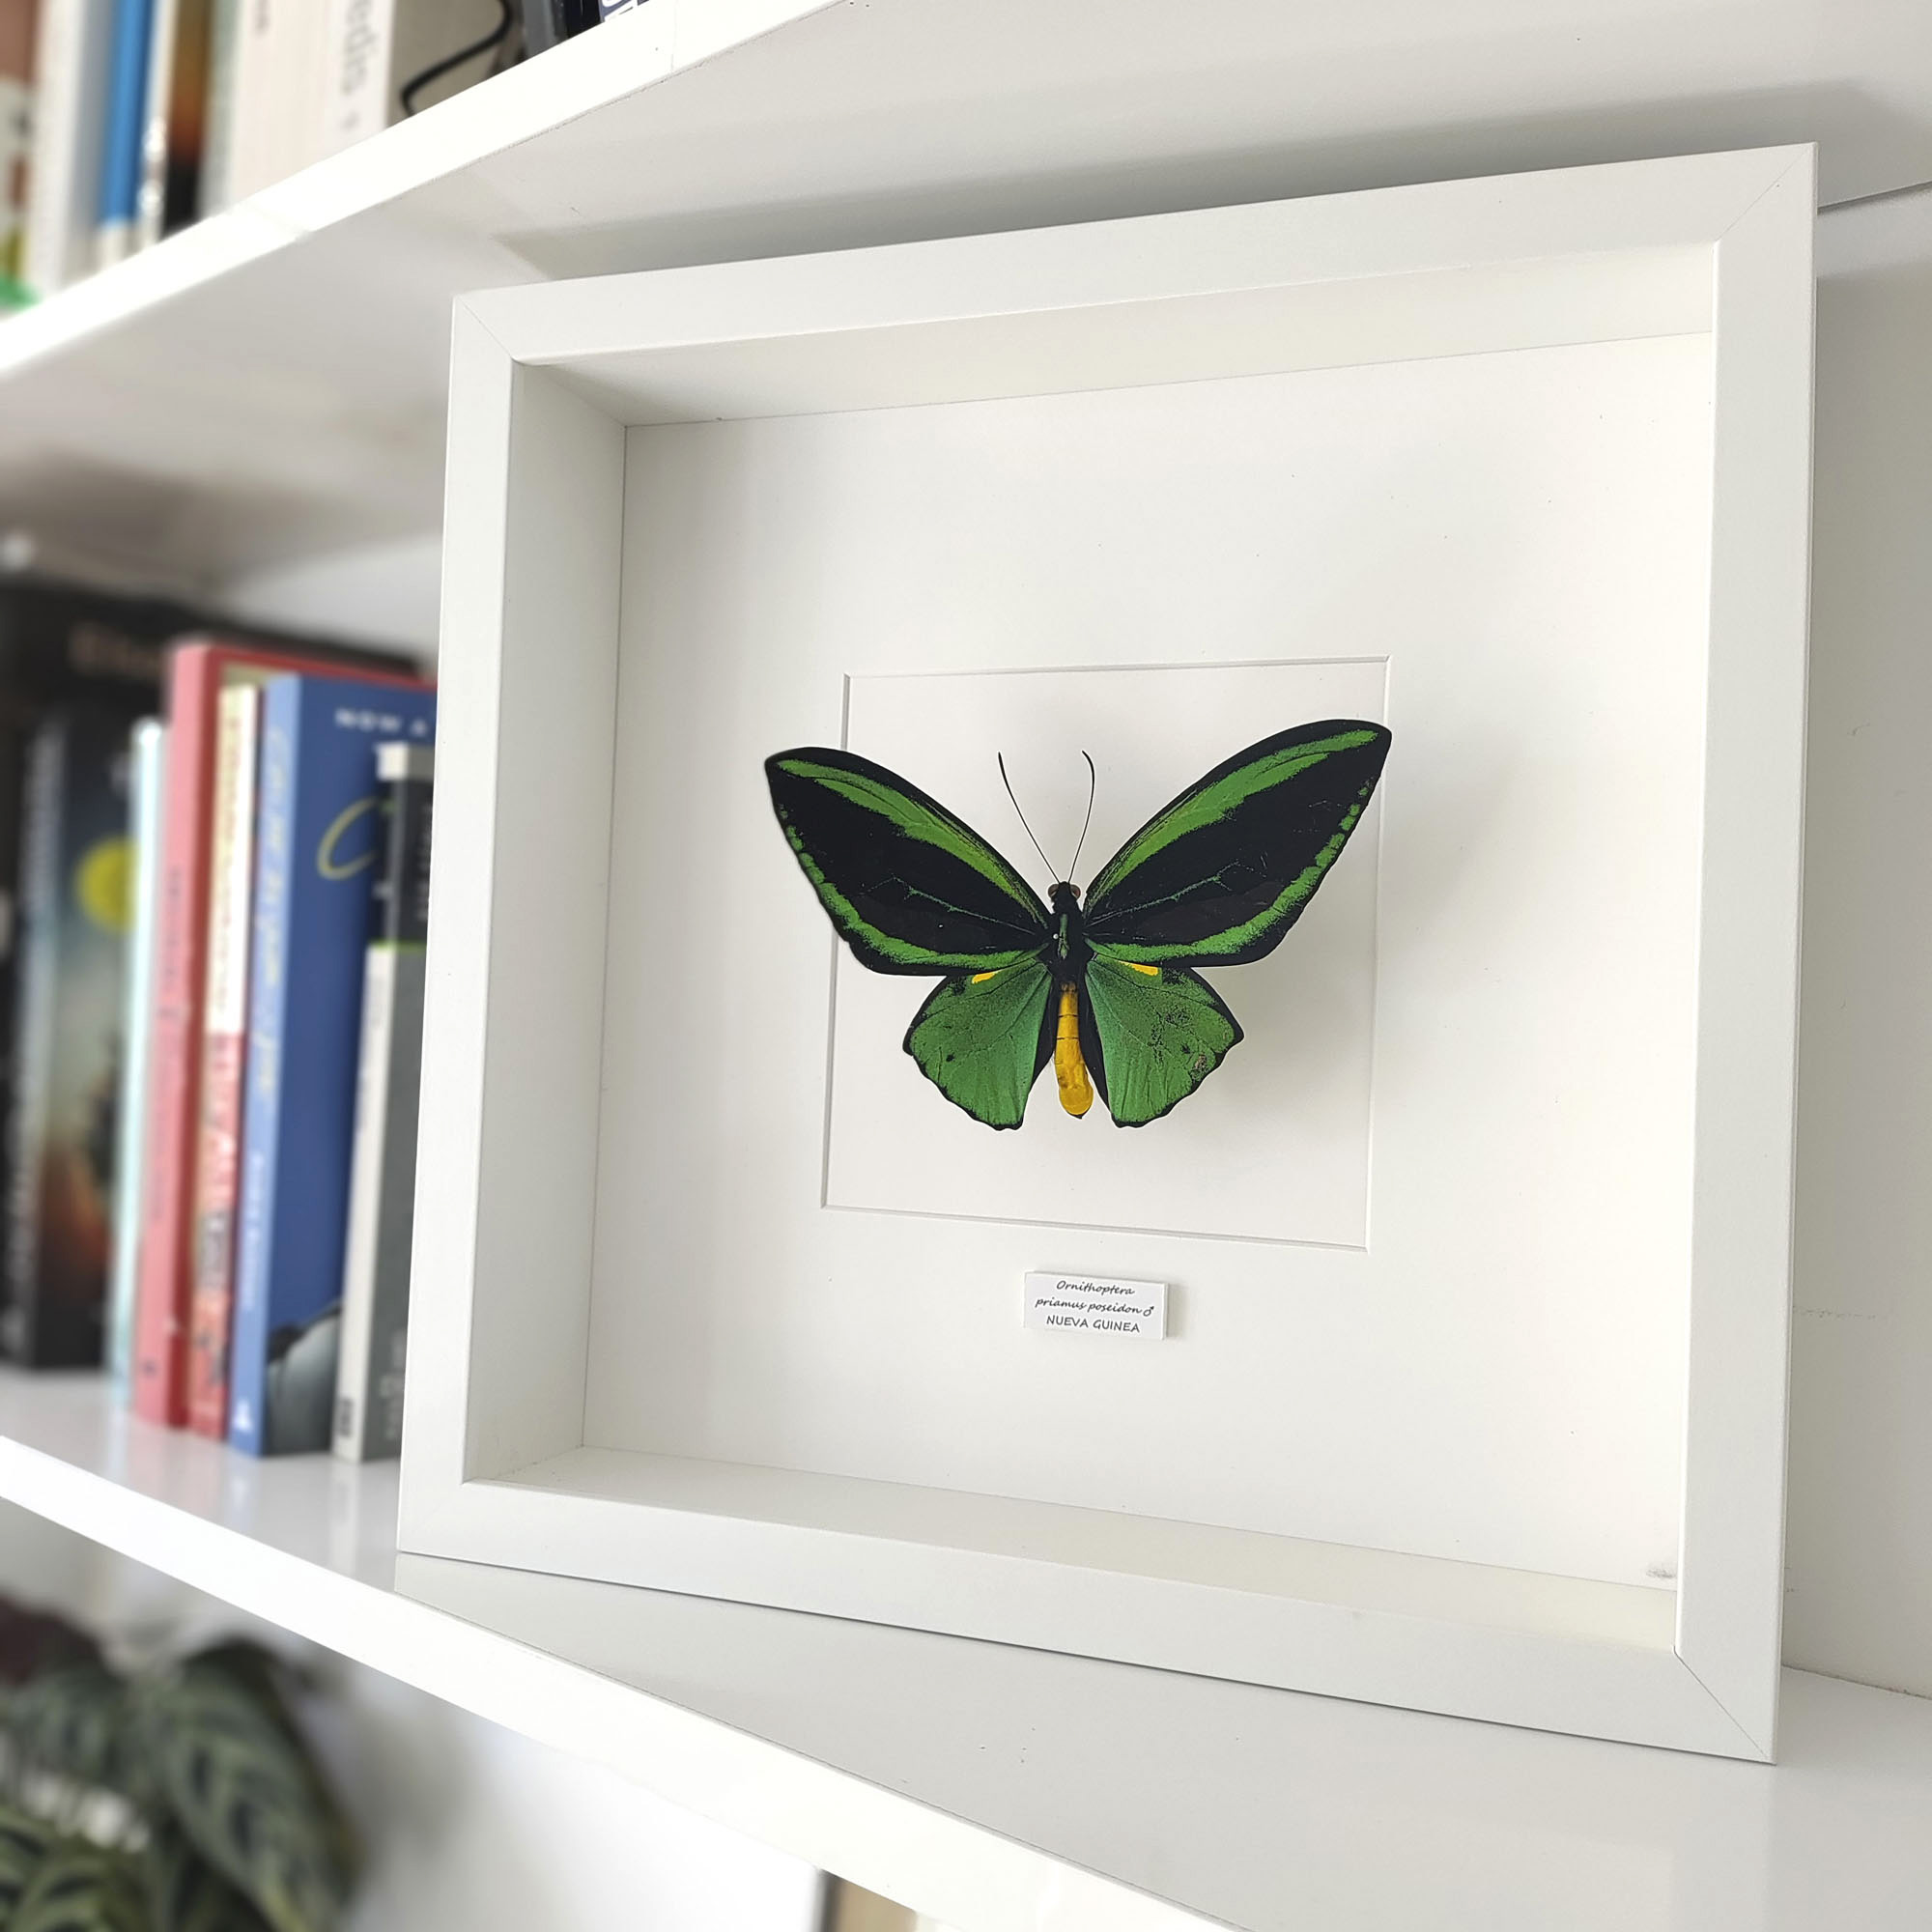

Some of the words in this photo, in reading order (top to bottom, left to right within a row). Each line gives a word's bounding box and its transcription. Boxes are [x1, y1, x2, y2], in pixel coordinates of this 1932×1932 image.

[1056, 1280, 1135, 1295] Ornithoptera
[1035, 1296, 1087, 1310] priamus
[1087, 1302, 1143, 1315] poseidon
[1046, 1315, 1089, 1328] NUEVA
[1093, 1319, 1140, 1333] GUINEA
